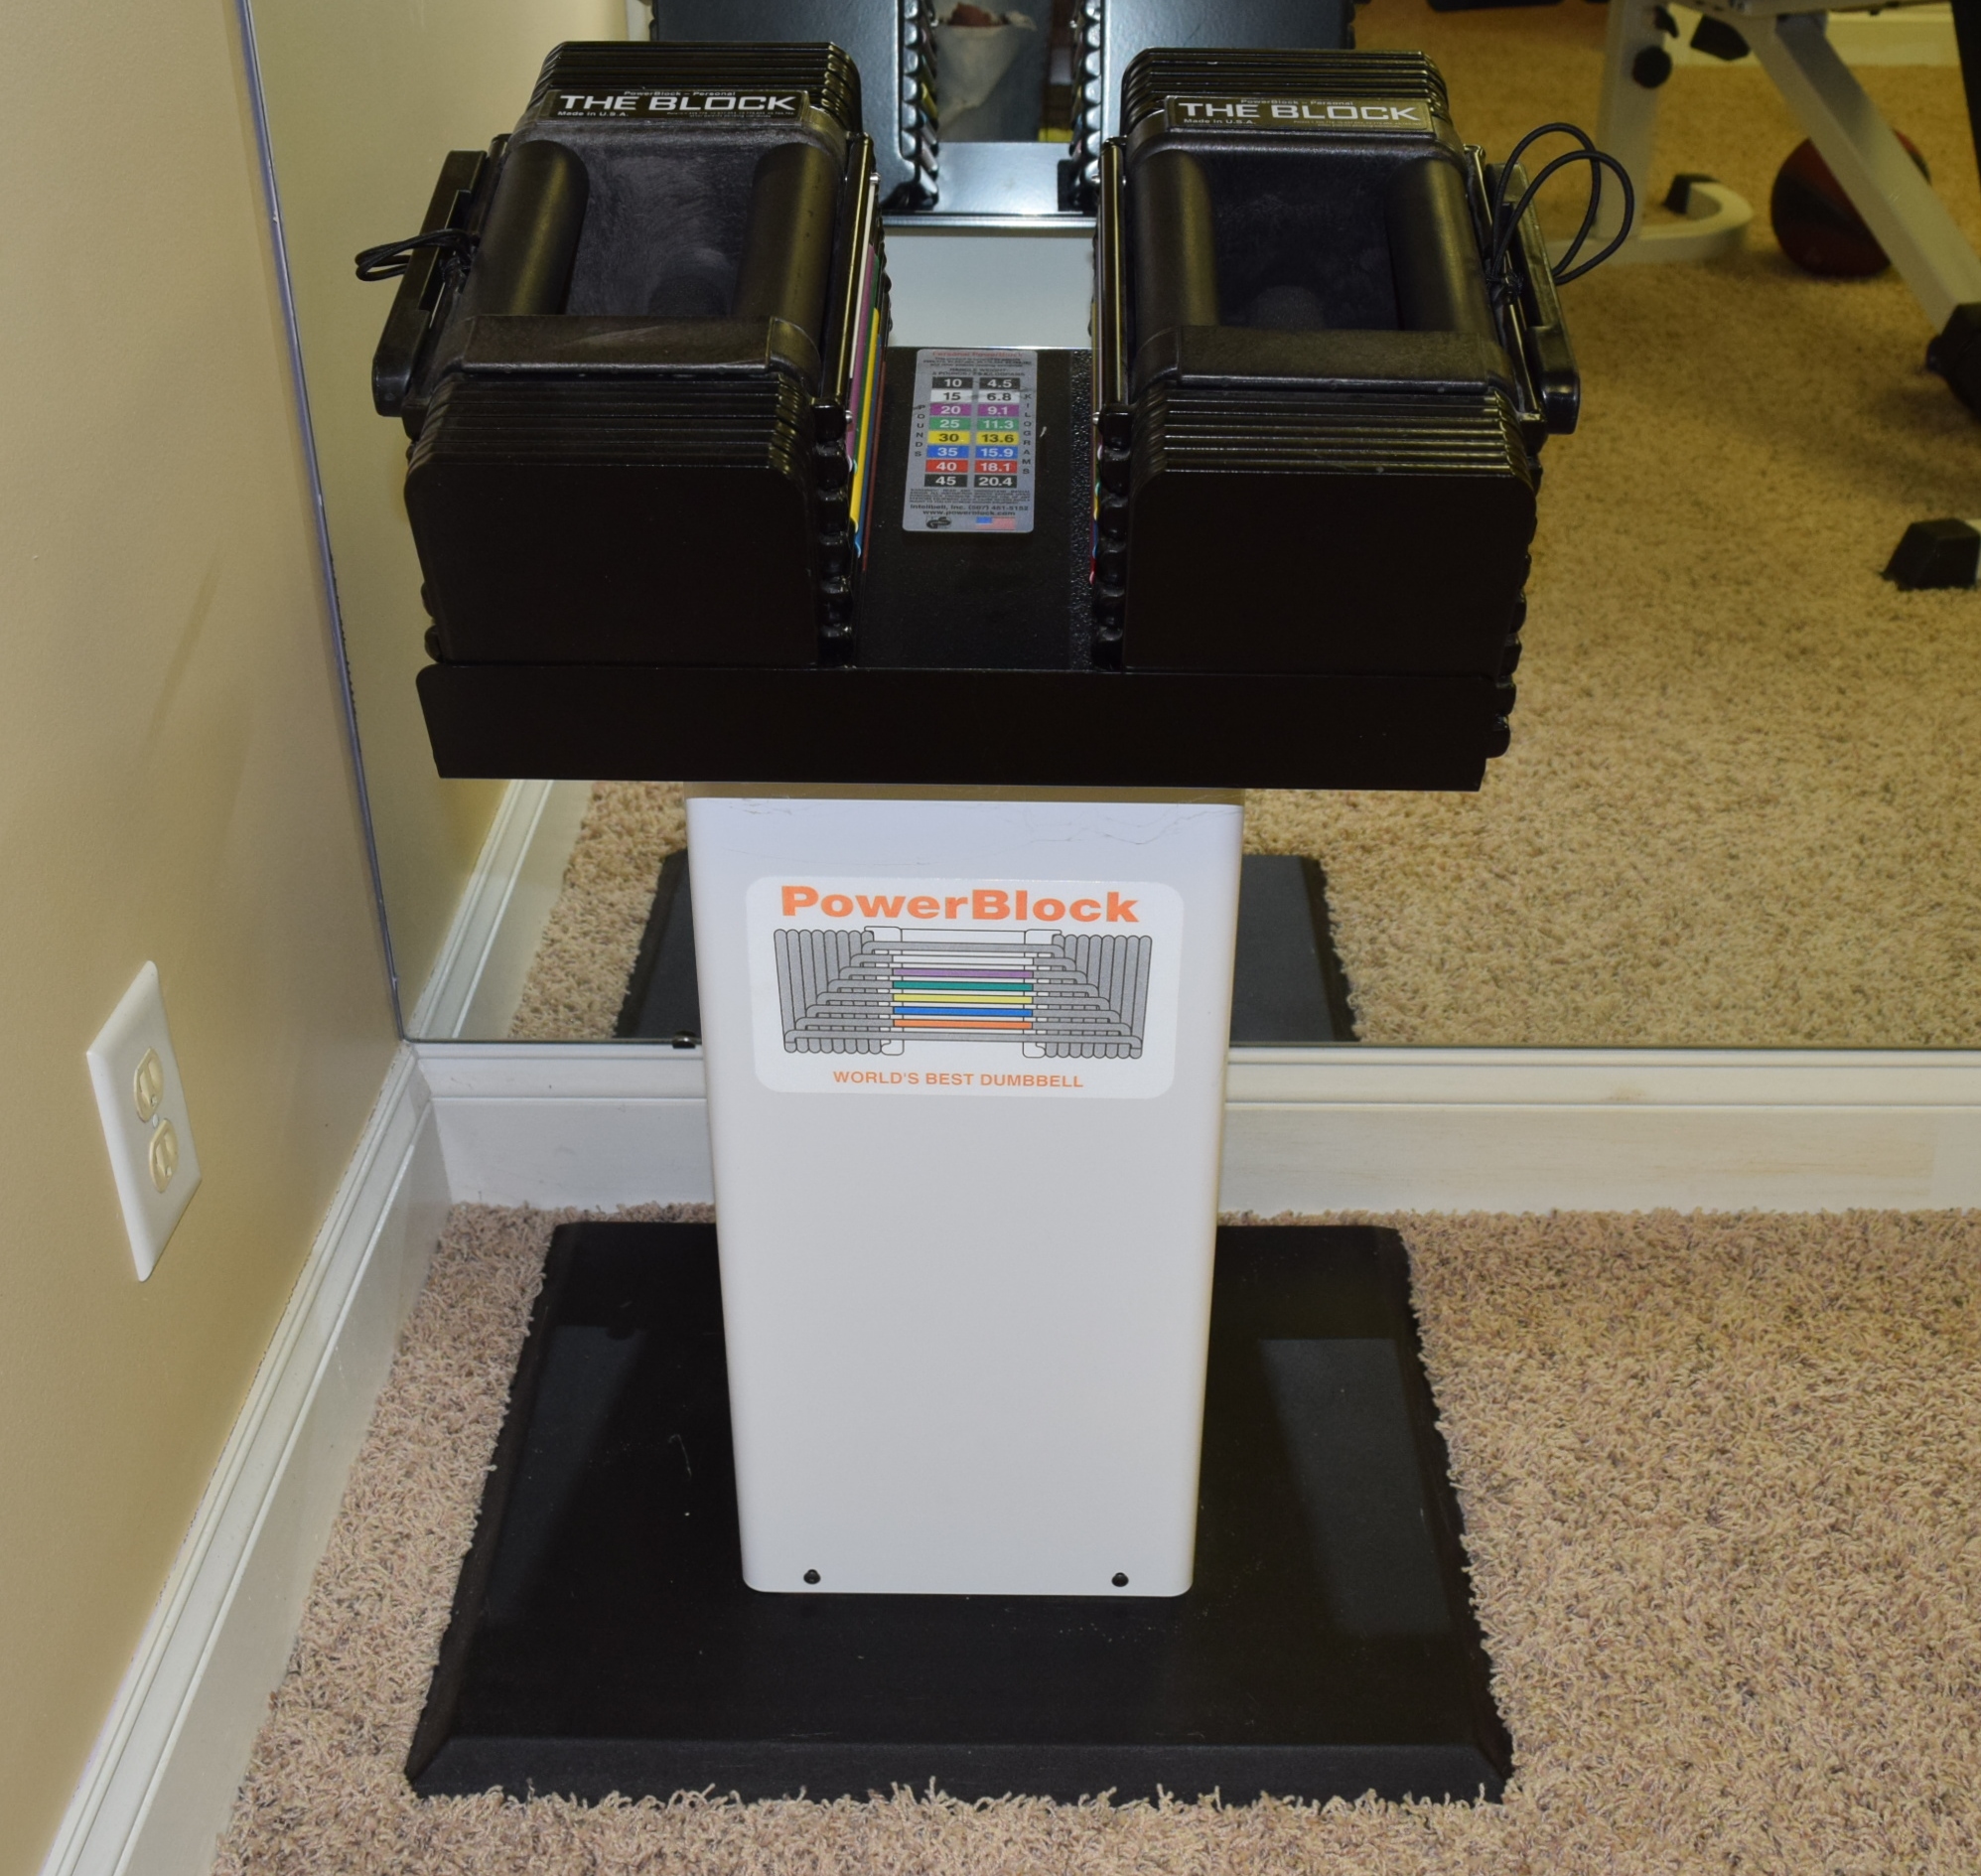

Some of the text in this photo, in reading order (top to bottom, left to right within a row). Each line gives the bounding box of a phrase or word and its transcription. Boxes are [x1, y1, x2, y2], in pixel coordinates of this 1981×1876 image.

[559, 94, 796, 111] THE BLOCK
[1178, 102, 1421, 121] THE BLOCK
[943, 378, 1013, 389] 10 4.5
[942, 391, 1012, 402] 15 6.8
[940, 405, 1009, 415] 20 9.1
[939, 419, 1014, 429] 25 11.3
[914, 404, 926, 458] POUNDS
[1022, 393, 1033, 475] KILOGRAMS
[938, 433, 1015, 443] 30 13.6
[937, 447, 1014, 458] 35 15.9
[935, 462, 1011, 472] 40 18.1
[934, 476, 1013, 487] 45 20.4
[780, 885, 1140, 924] PowerBlock
[833, 1071, 1083, 1088] WORLD'S BEST DUMBBELL
